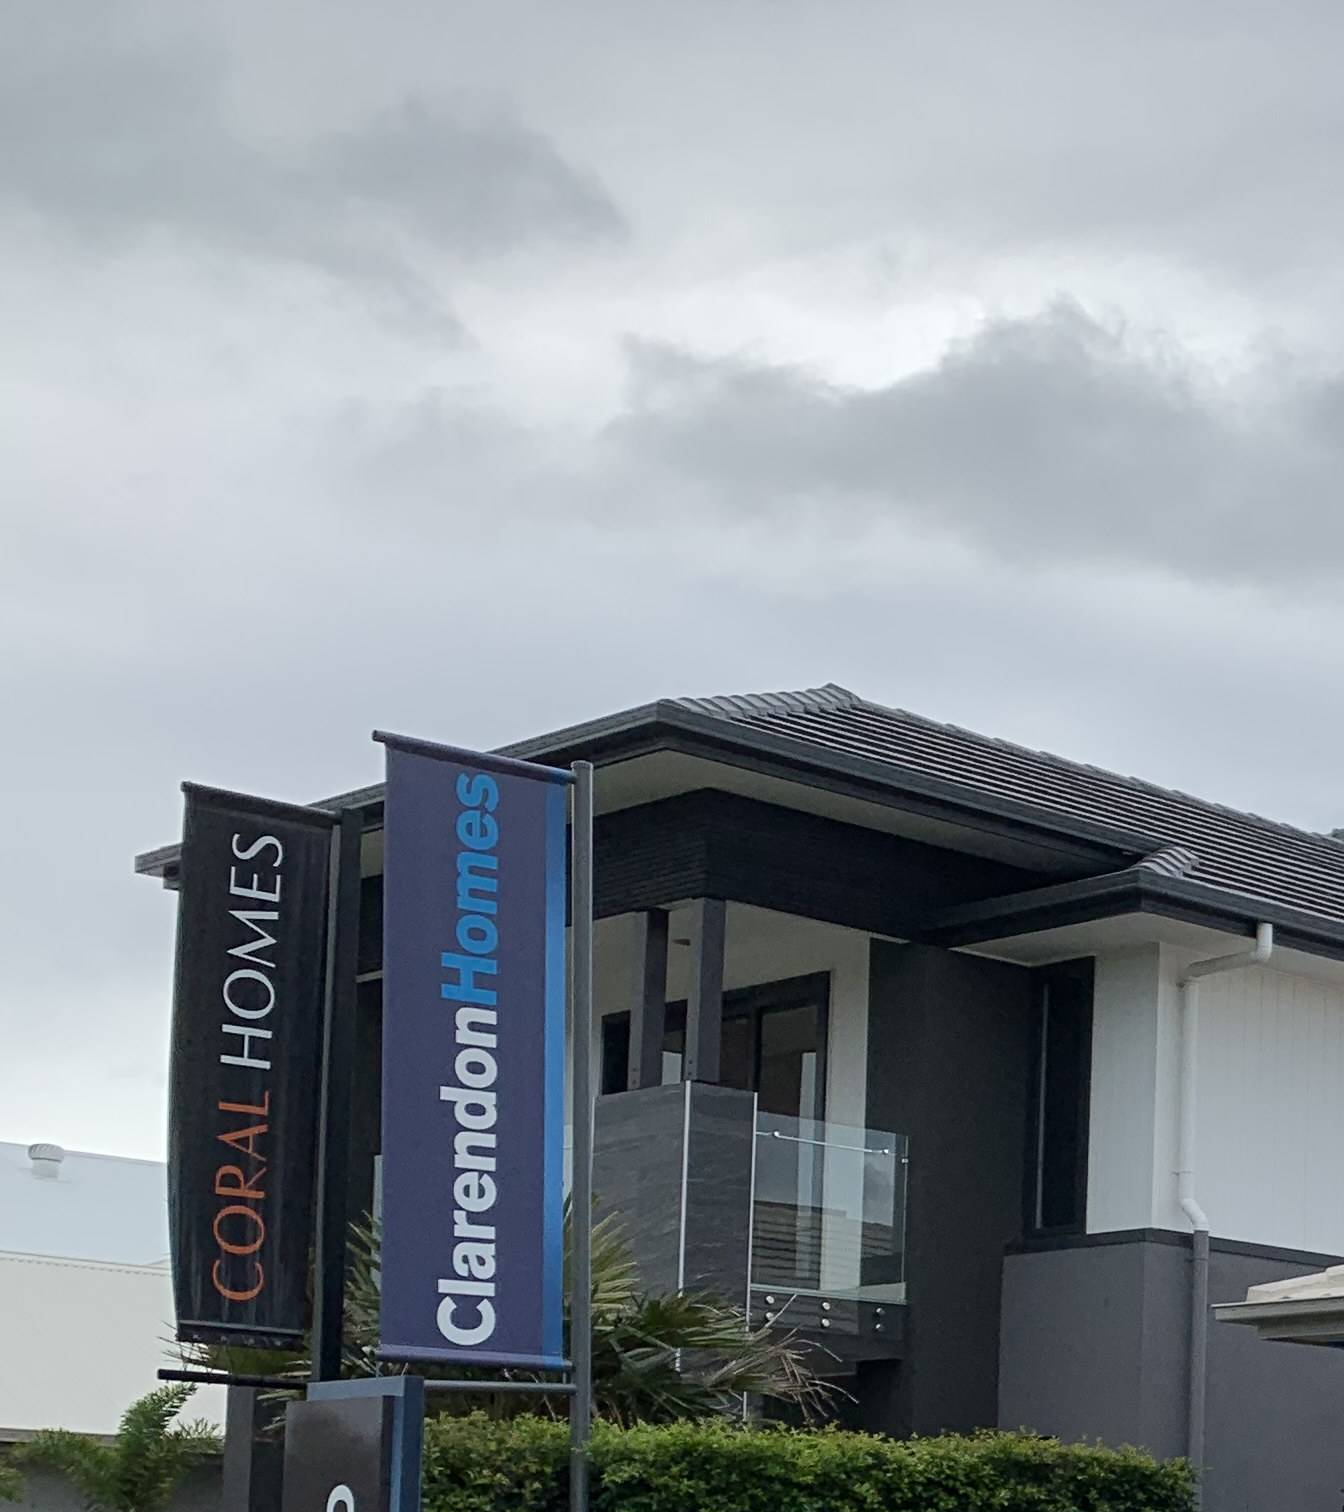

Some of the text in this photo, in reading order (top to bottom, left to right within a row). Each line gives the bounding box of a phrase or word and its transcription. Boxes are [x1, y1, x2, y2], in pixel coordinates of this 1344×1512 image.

[212, 832, 284, 1301] CORAL HOMES
[437, 770, 500, 1346] ClarendonHomes
